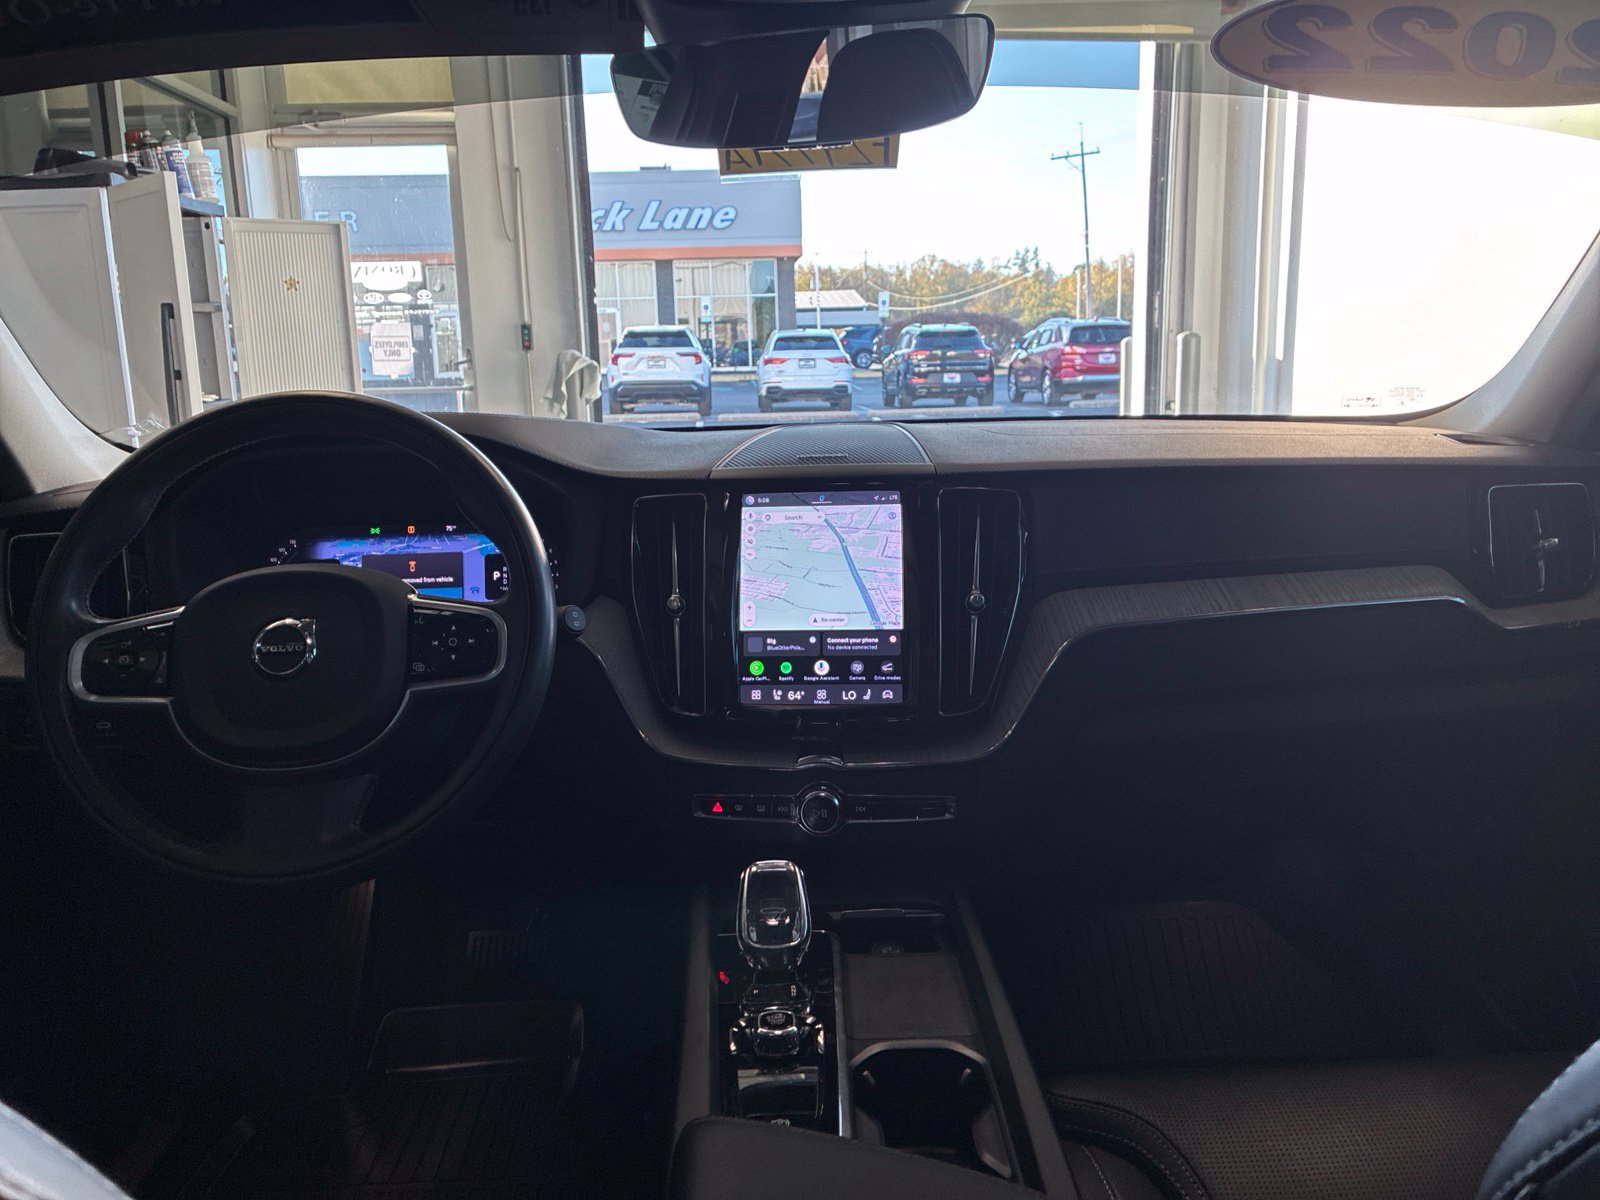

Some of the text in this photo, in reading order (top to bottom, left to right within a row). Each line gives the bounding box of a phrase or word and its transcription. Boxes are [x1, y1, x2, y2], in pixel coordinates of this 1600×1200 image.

[638, 199, 738, 232] Lane
[493, 571, 501, 581] P
[861, 637, 879, 645] phone
[260, 644, 304, 653] VOLVO
[842, 690, 857, 700] LO
